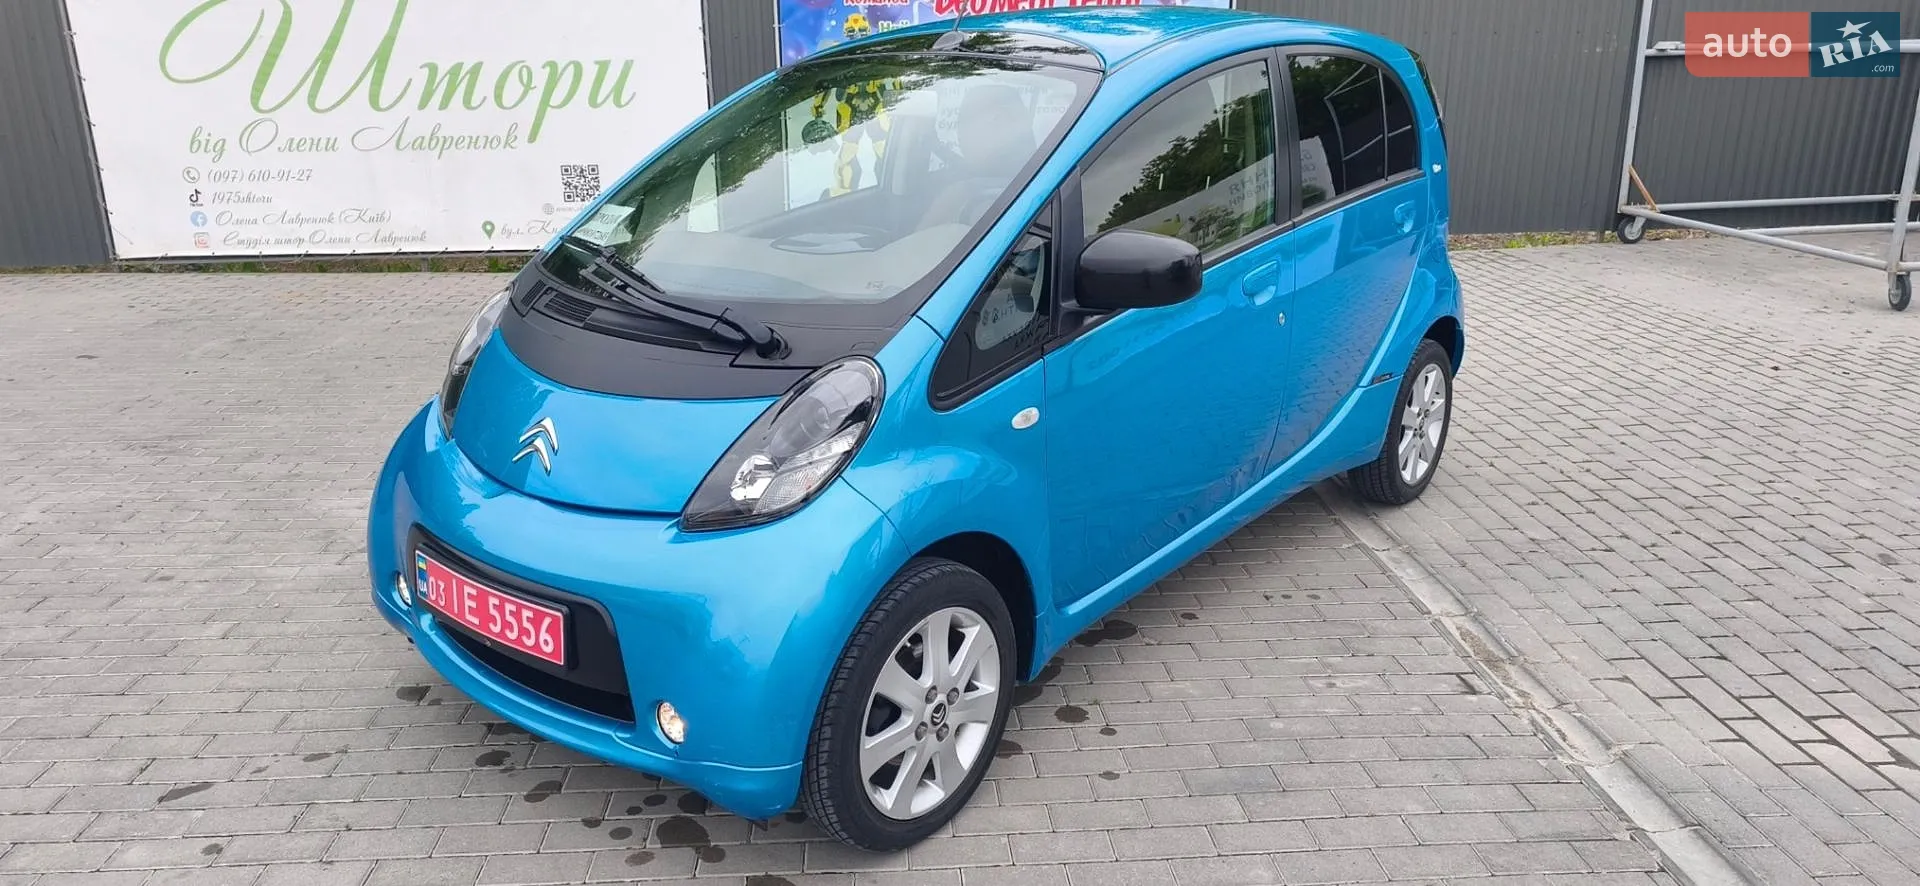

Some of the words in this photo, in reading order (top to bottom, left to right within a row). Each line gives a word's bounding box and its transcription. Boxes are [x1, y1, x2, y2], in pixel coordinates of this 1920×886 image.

[158, 0, 636, 144] Штори
[189, 126, 227, 163] від
[239, 117, 339, 157] Олени
[351, 115, 519, 160] Лавренюк
[207, 168, 244, 184] (097)
[248, 168, 313, 183] 610-91-27
[215, 210, 258, 226] Олена
[262, 210, 335, 227] Лавренюк
[223, 231, 269, 248] Студія
[355, 229, 427, 247] Лавренюк
[419, 583, 428, 596] UA
[489, 596, 555, 653] 5556
